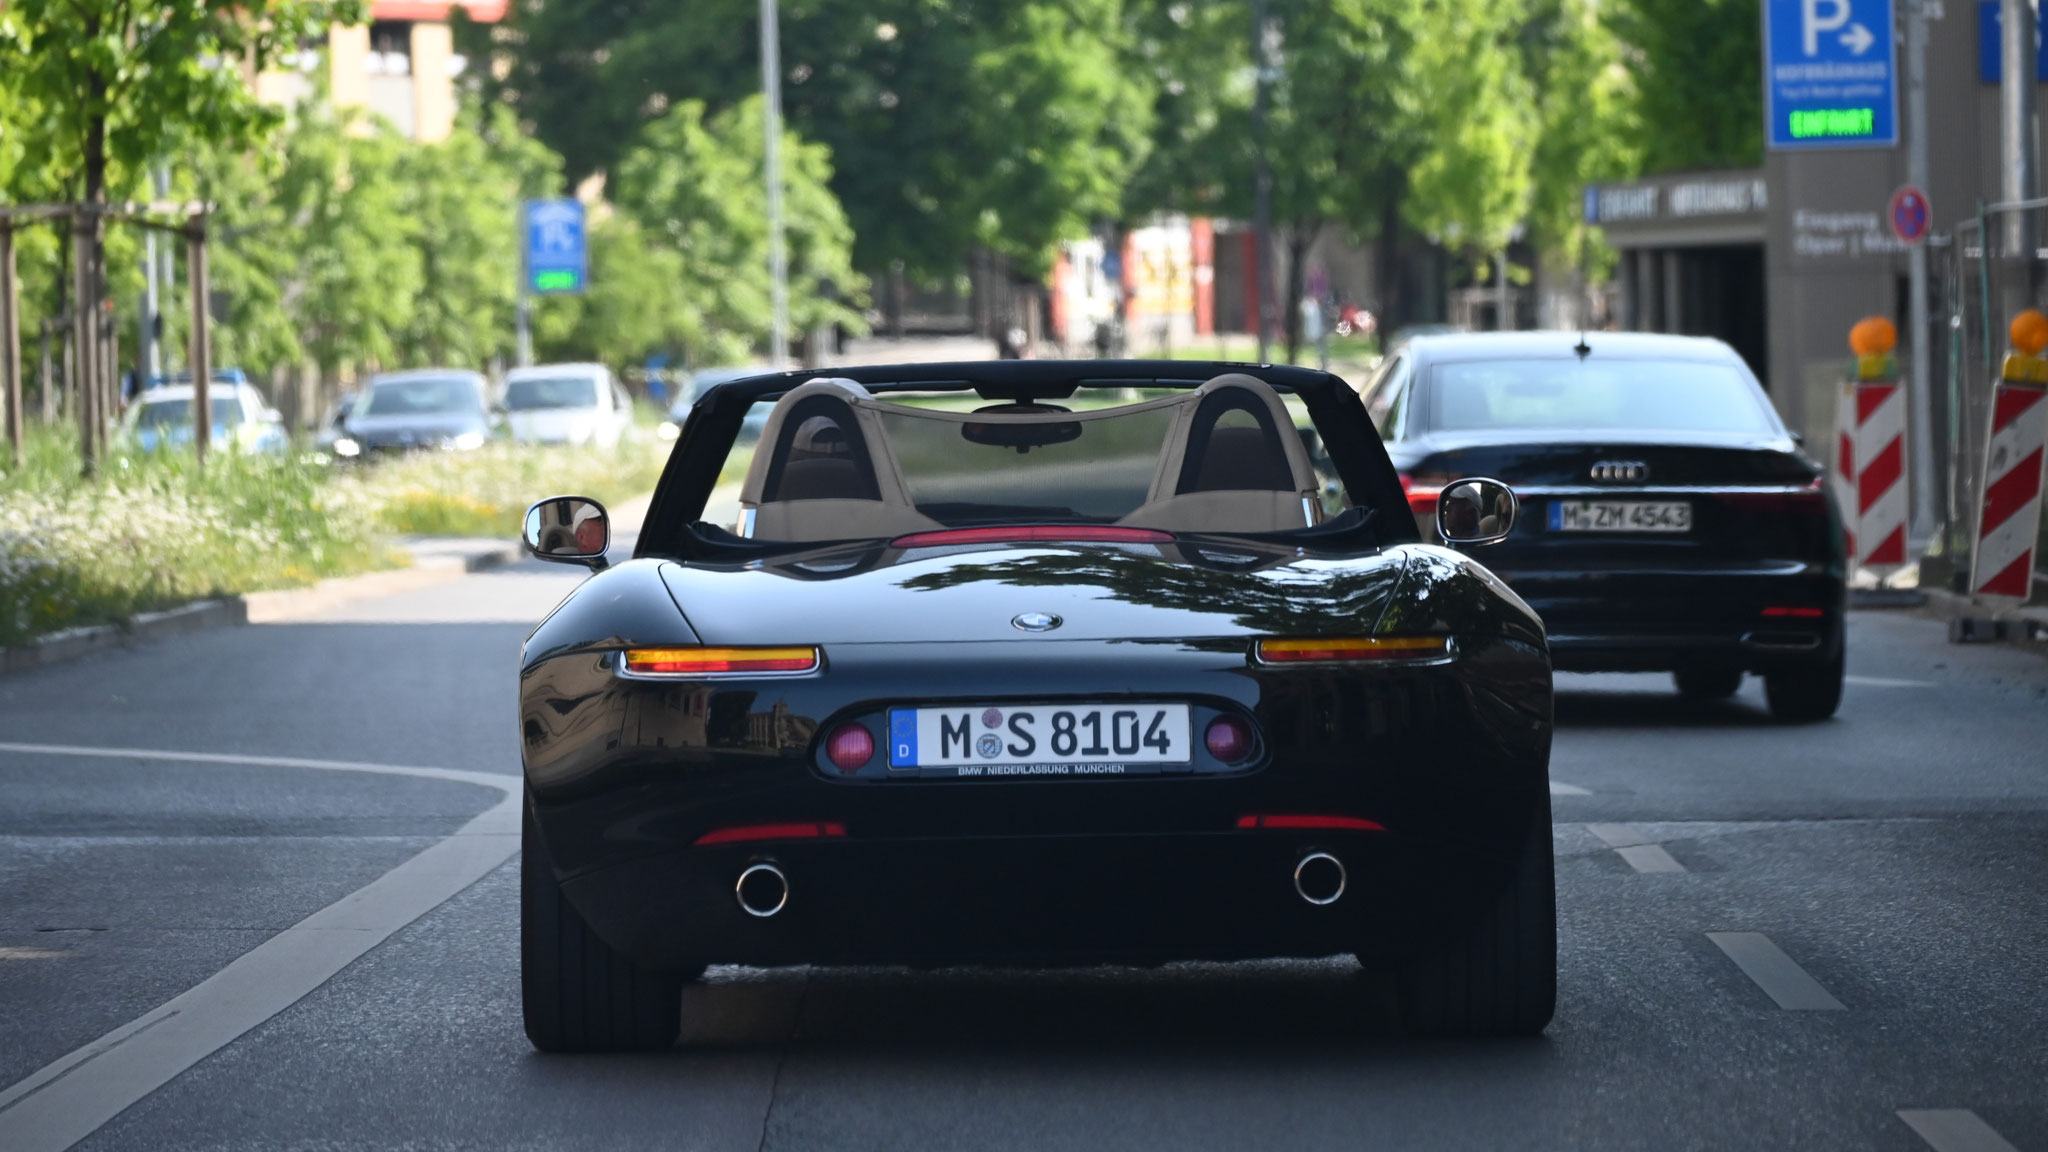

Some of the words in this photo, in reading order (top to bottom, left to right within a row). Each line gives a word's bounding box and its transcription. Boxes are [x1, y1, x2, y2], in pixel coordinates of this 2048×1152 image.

[1803, 0, 1850, 57] P
[1563, 506, 1578, 526] M
[1595, 506, 1624, 527] ZM
[1630, 506, 1689, 527] 4543
[940, 713, 971, 759] M
[1007, 712, 1036, 757] S
[1050, 710, 1171, 757] 8104
[898, 744, 910, 758] D
[958, 766, 983, 776] BMW
[987, 764, 1069, 775] NIEDERLASSUNG
